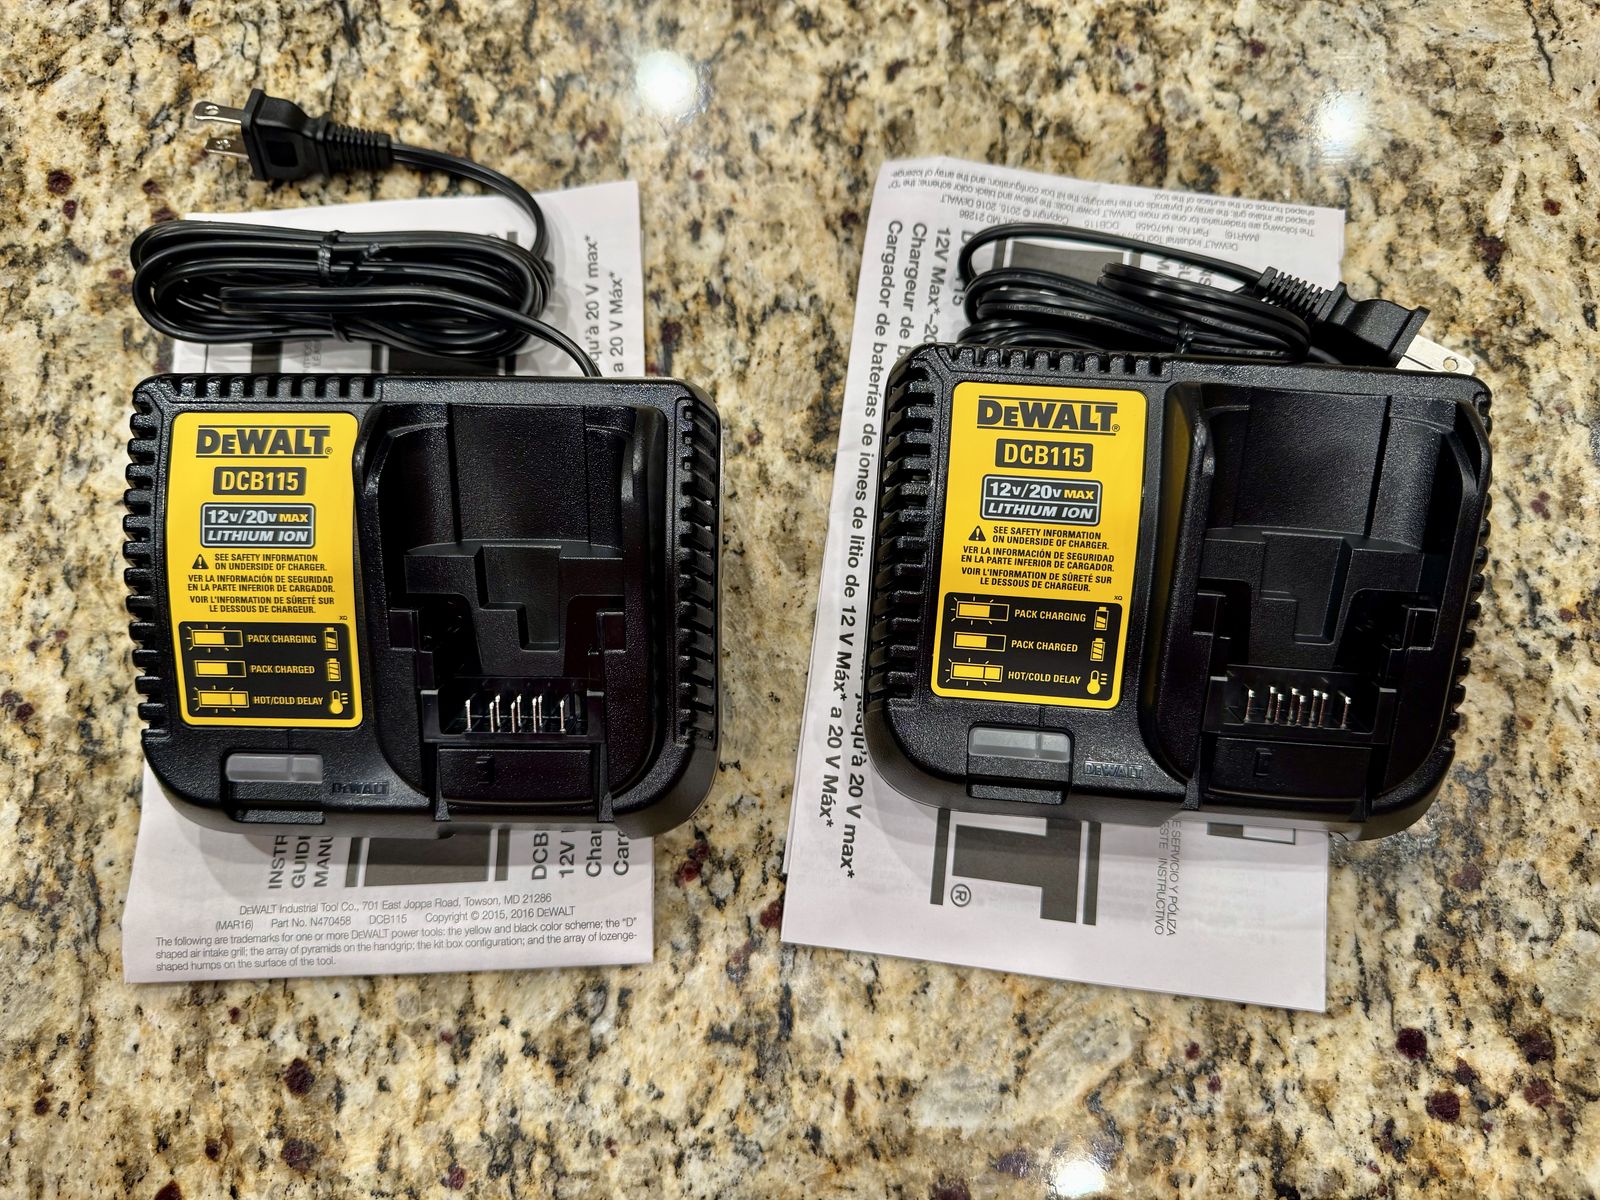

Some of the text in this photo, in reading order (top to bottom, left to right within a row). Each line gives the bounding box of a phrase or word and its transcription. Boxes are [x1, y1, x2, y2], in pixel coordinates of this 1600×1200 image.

[934, 228, 951, 263] 12V
[879, 220, 903, 309] Cargador
[902, 222, 927, 312] Chargeur
[585, 284, 599, 297] V
[585, 301, 599, 320] 20
[609, 321, 623, 333] V
[875, 313, 890, 337] de
[900, 316, 915, 340] de
[609, 336, 624, 356] 20
[614, 363, 624, 373] a
[865, 342, 888, 418] baterías
[861, 423, 877, 447] de
[1004, 443, 1085, 467] DCB115
[221, 470, 298, 491] DCB115
[855, 451, 876, 501] iones
[1064, 490, 1094, 499] MAX
[279, 513, 308, 522] MAX
[852, 506, 868, 530] de
[988, 503, 1093, 519] LITHIUM ION
[208, 530, 308, 542] LITHIUM ION
[993, 526, 1101, 540] SEE SAFETY INFORMATION
[992, 535, 1109, 550] ON UNDERSIDE OF CHARGER.
[231, 554, 260, 562] SAFETY
[262, 554, 318, 562] INFORMATION
[847, 534, 865, 569] litio
[963, 546, 1115, 563] VER LA INFORMACIÓN DE SEGURIDAD
[215, 562, 328, 571] ON UNDERSIDE OF CHARGER.
[961, 555, 1115, 572] EN LA PARTE INFERIOR DE CARGADOR.
[205, 575, 215, 583] LA
[217, 573, 273, 583] INFORMACIÓN
[961, 567, 1112, 584] VOIR L'INFORMATION DE SÛRETÉ SUR
[212, 584, 237, 592] PARTE
[238, 584, 274, 592] INFERIOR
[289, 585, 335, 593] CARGADOR.
[844, 574, 860, 598] de
[980, 577, 1091, 592] LE DESSOUS DE CHARGEUR.
[190, 596, 208, 604] VOIR
[210, 596, 271, 604] L'INFORMATION
[286, 595, 316, 605] SÛRETÉ
[318, 597, 335, 605] SUR
[220, 605, 257, 613] DESSOUS
[259, 605, 269, 613] DE
[840, 604, 857, 627] 12
[1014, 609, 1086, 622] PACK CHARGING
[248, 634, 317, 644] PACK CHARGING
[838, 632, 854, 647] V
[1011, 640, 1078, 652] PACK CHARGED
[250, 665, 315, 674] PACK CHARGED
[1008, 671, 1081, 685] HOT/COLD DELAY
[254, 696, 323, 705] HOT/COLD DELAY
[830, 707, 843, 719] a
[827, 725, 843, 748] 20
[825, 755, 841, 769] V
[847, 773, 864, 798] 20
[846, 804, 862, 819] V
[558, 840, 575, 879] 12V
[1169, 830, 1181, 882] SERVICIO
[1154, 857, 1167, 935] INSTRUCTIVO
[1168, 884, 1178, 894] Y
[279, 902, 318, 914] Industrial
[321, 902, 339, 913] Tool
[362, 901, 379, 911] 701
[382, 899, 401, 910] East
[403, 898, 432, 911] Joppa
[435, 897, 461, 909] Road,
[464, 896, 501, 908] Towson,
[504, 894, 520, 905] MD
[522, 893, 552, 905] 21286
[215, 918, 253, 931] (MAR16)
[271, 918, 290, 928] Part
[292, 917, 308, 927] No.
[310, 916, 351, 927] N470458
[369, 913, 407, 925] DCB115
[425, 911, 468, 925] Copyright
[482, 909, 509, 921] 2015,
[511, 908, 535, 919] 2016
[1166, 895, 1180, 936] PÓLIZA
[156, 955, 337, 972] shaped humps on the surface of the tool.
